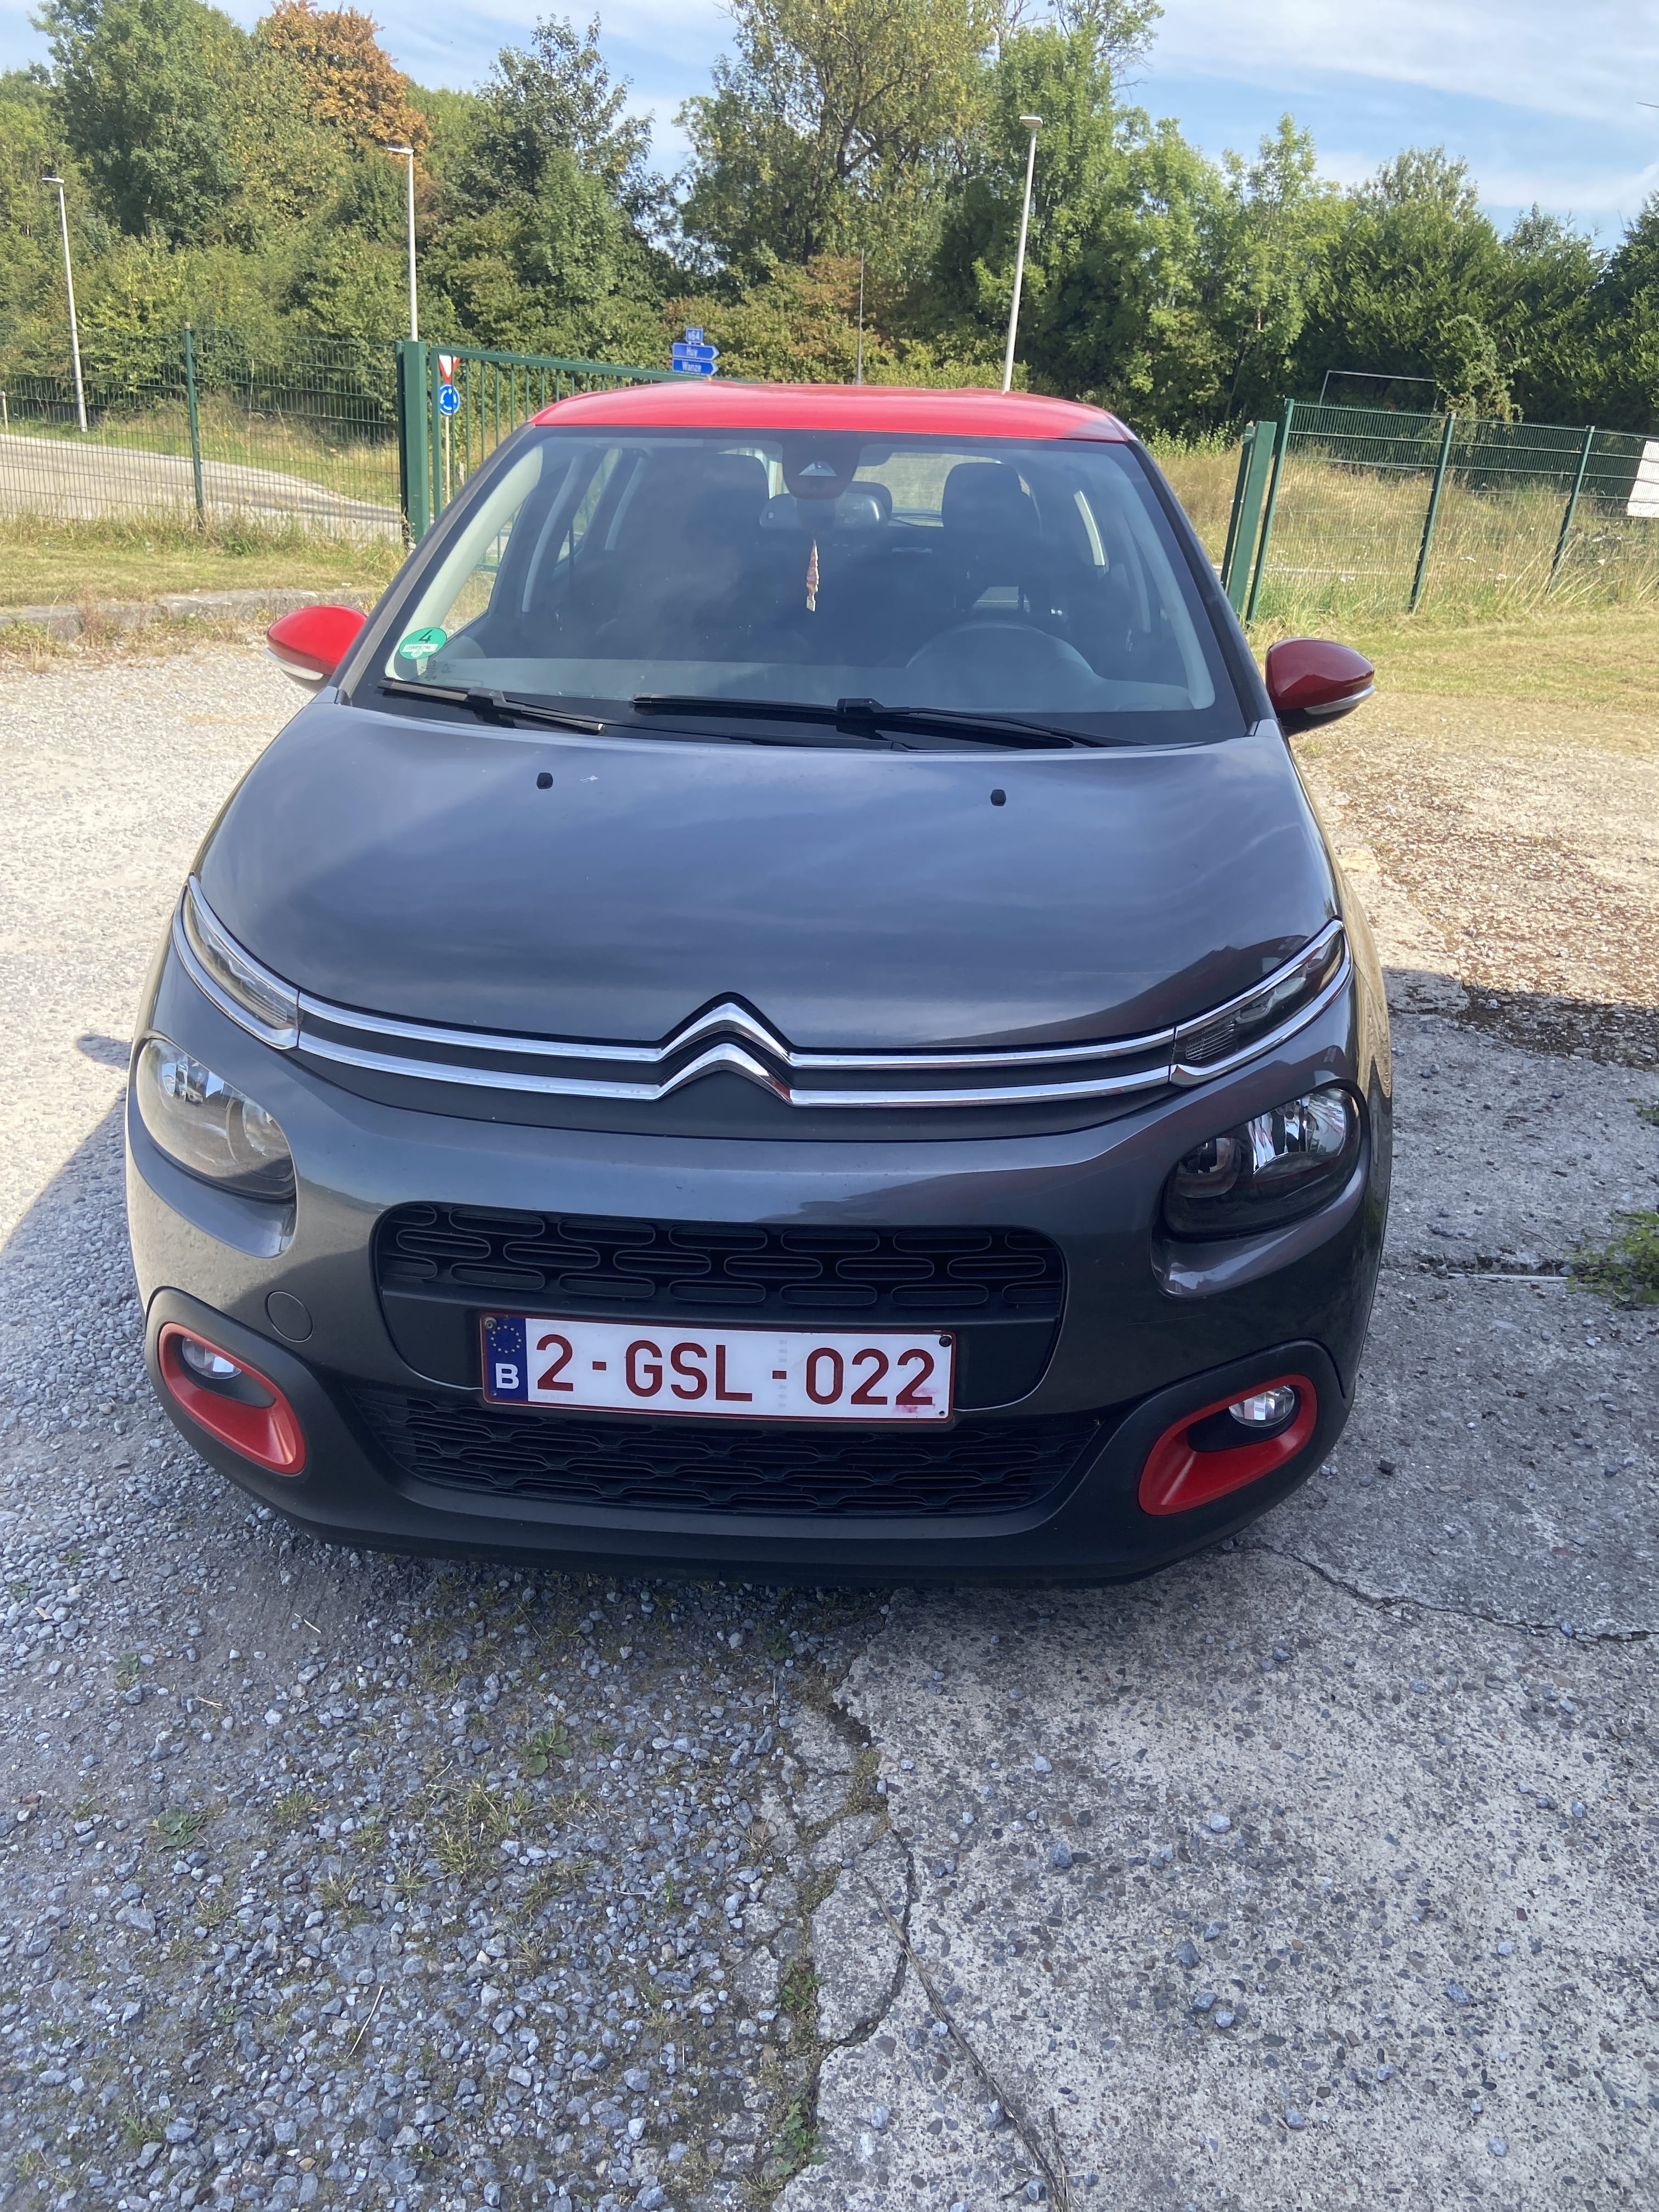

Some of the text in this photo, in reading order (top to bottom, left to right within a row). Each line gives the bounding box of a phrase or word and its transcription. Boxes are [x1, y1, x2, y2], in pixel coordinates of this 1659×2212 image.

[687, 331, 700, 340] N64
[686, 346, 698, 357] Huy
[682, 362, 701, 372] Wanze
[418, 629, 433, 644] 4
[495, 1363, 519, 1390] B
